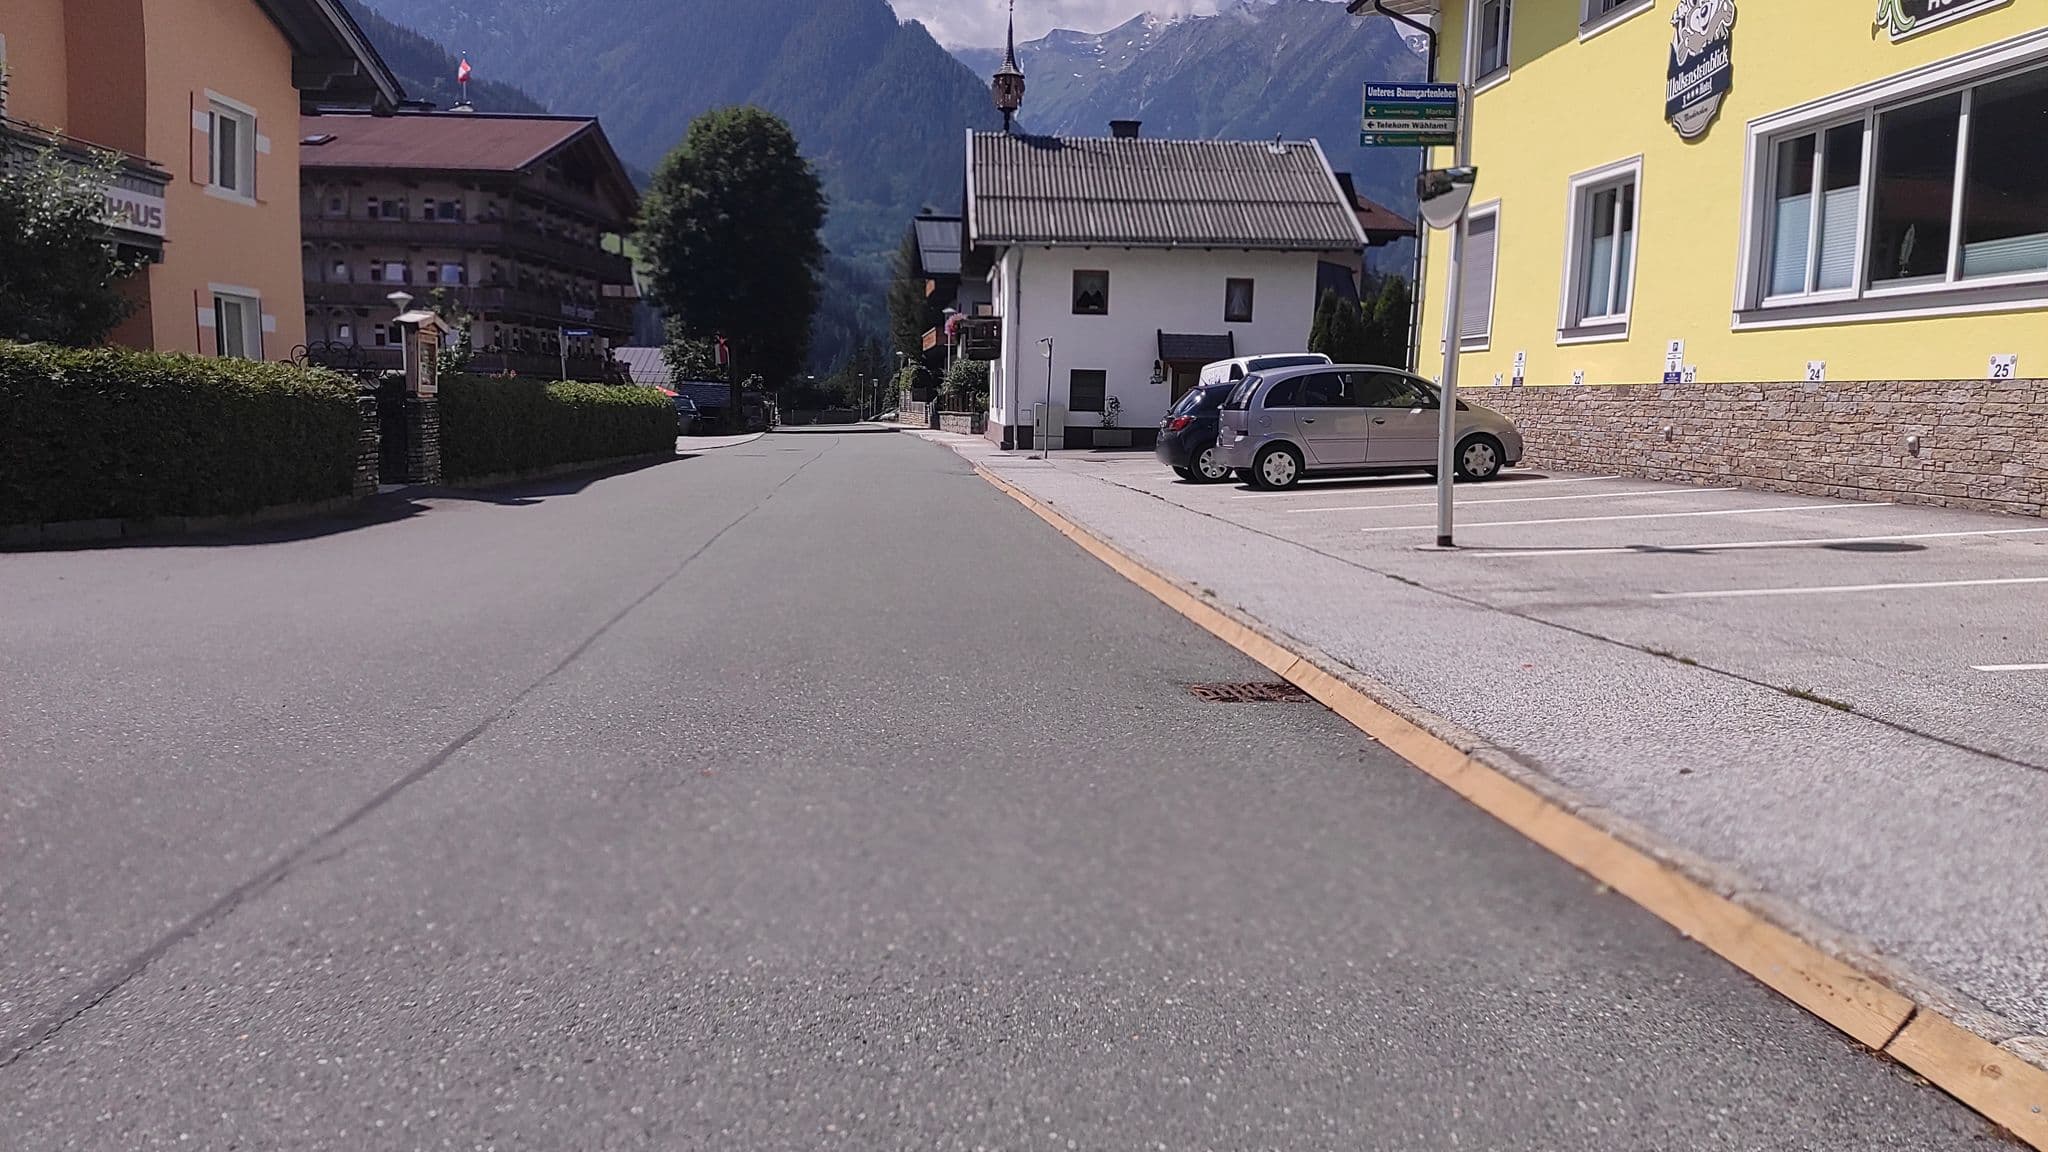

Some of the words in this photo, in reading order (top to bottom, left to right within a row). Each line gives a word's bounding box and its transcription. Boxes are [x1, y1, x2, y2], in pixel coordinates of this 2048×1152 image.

[1667, 45, 1728, 100] Wolkensteinblick
[1368, 86, 1395, 97] Unteres
[1396, 87, 1456, 99] Baumgartenlehen
[1377, 121, 1410, 129] Telekom
[1411, 121, 1447, 129] Wählamt
[105, 196, 162, 229] HAUS
[1684, 372, 1693, 382] 23
[1809, 368, 1821, 381] 24
[1993, 363, 2010, 378] 25
